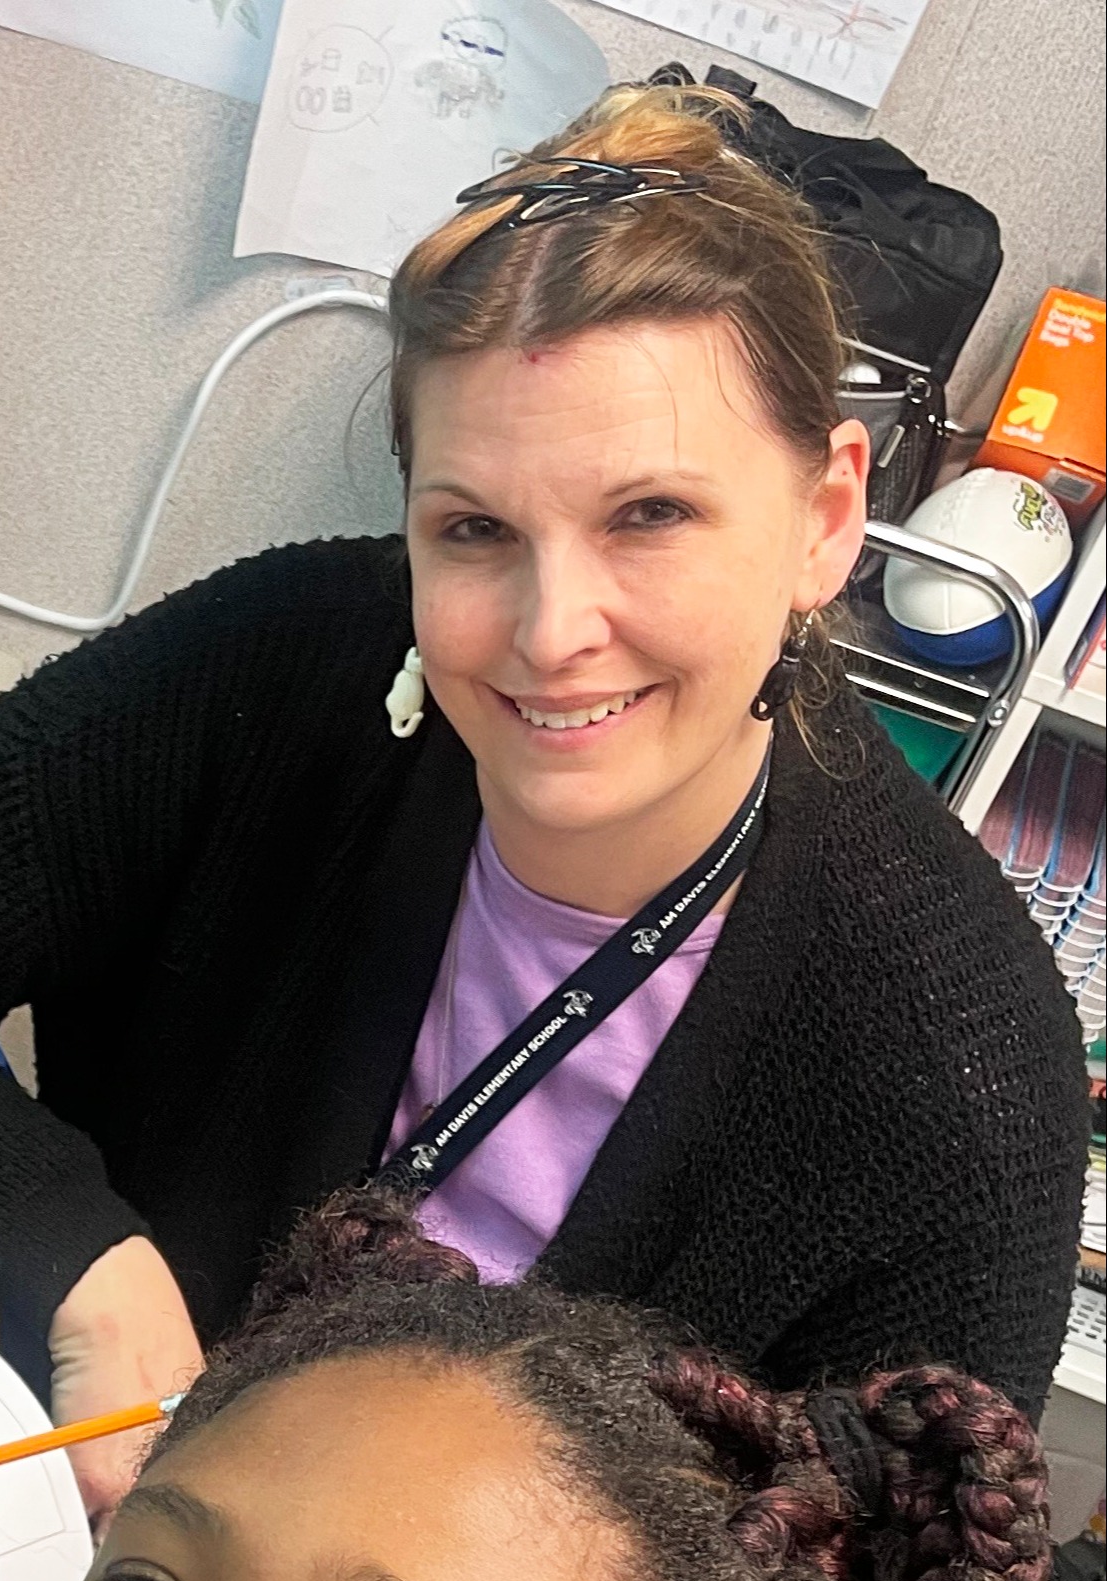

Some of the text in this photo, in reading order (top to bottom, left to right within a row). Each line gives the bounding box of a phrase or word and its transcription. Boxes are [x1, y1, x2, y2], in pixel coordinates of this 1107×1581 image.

[659, 911, 678, 930] AM
[674, 881, 707, 913] DAVIS
[435, 1014, 568, 1147] AM DAVIS ELEMENTARY SCHOOL
